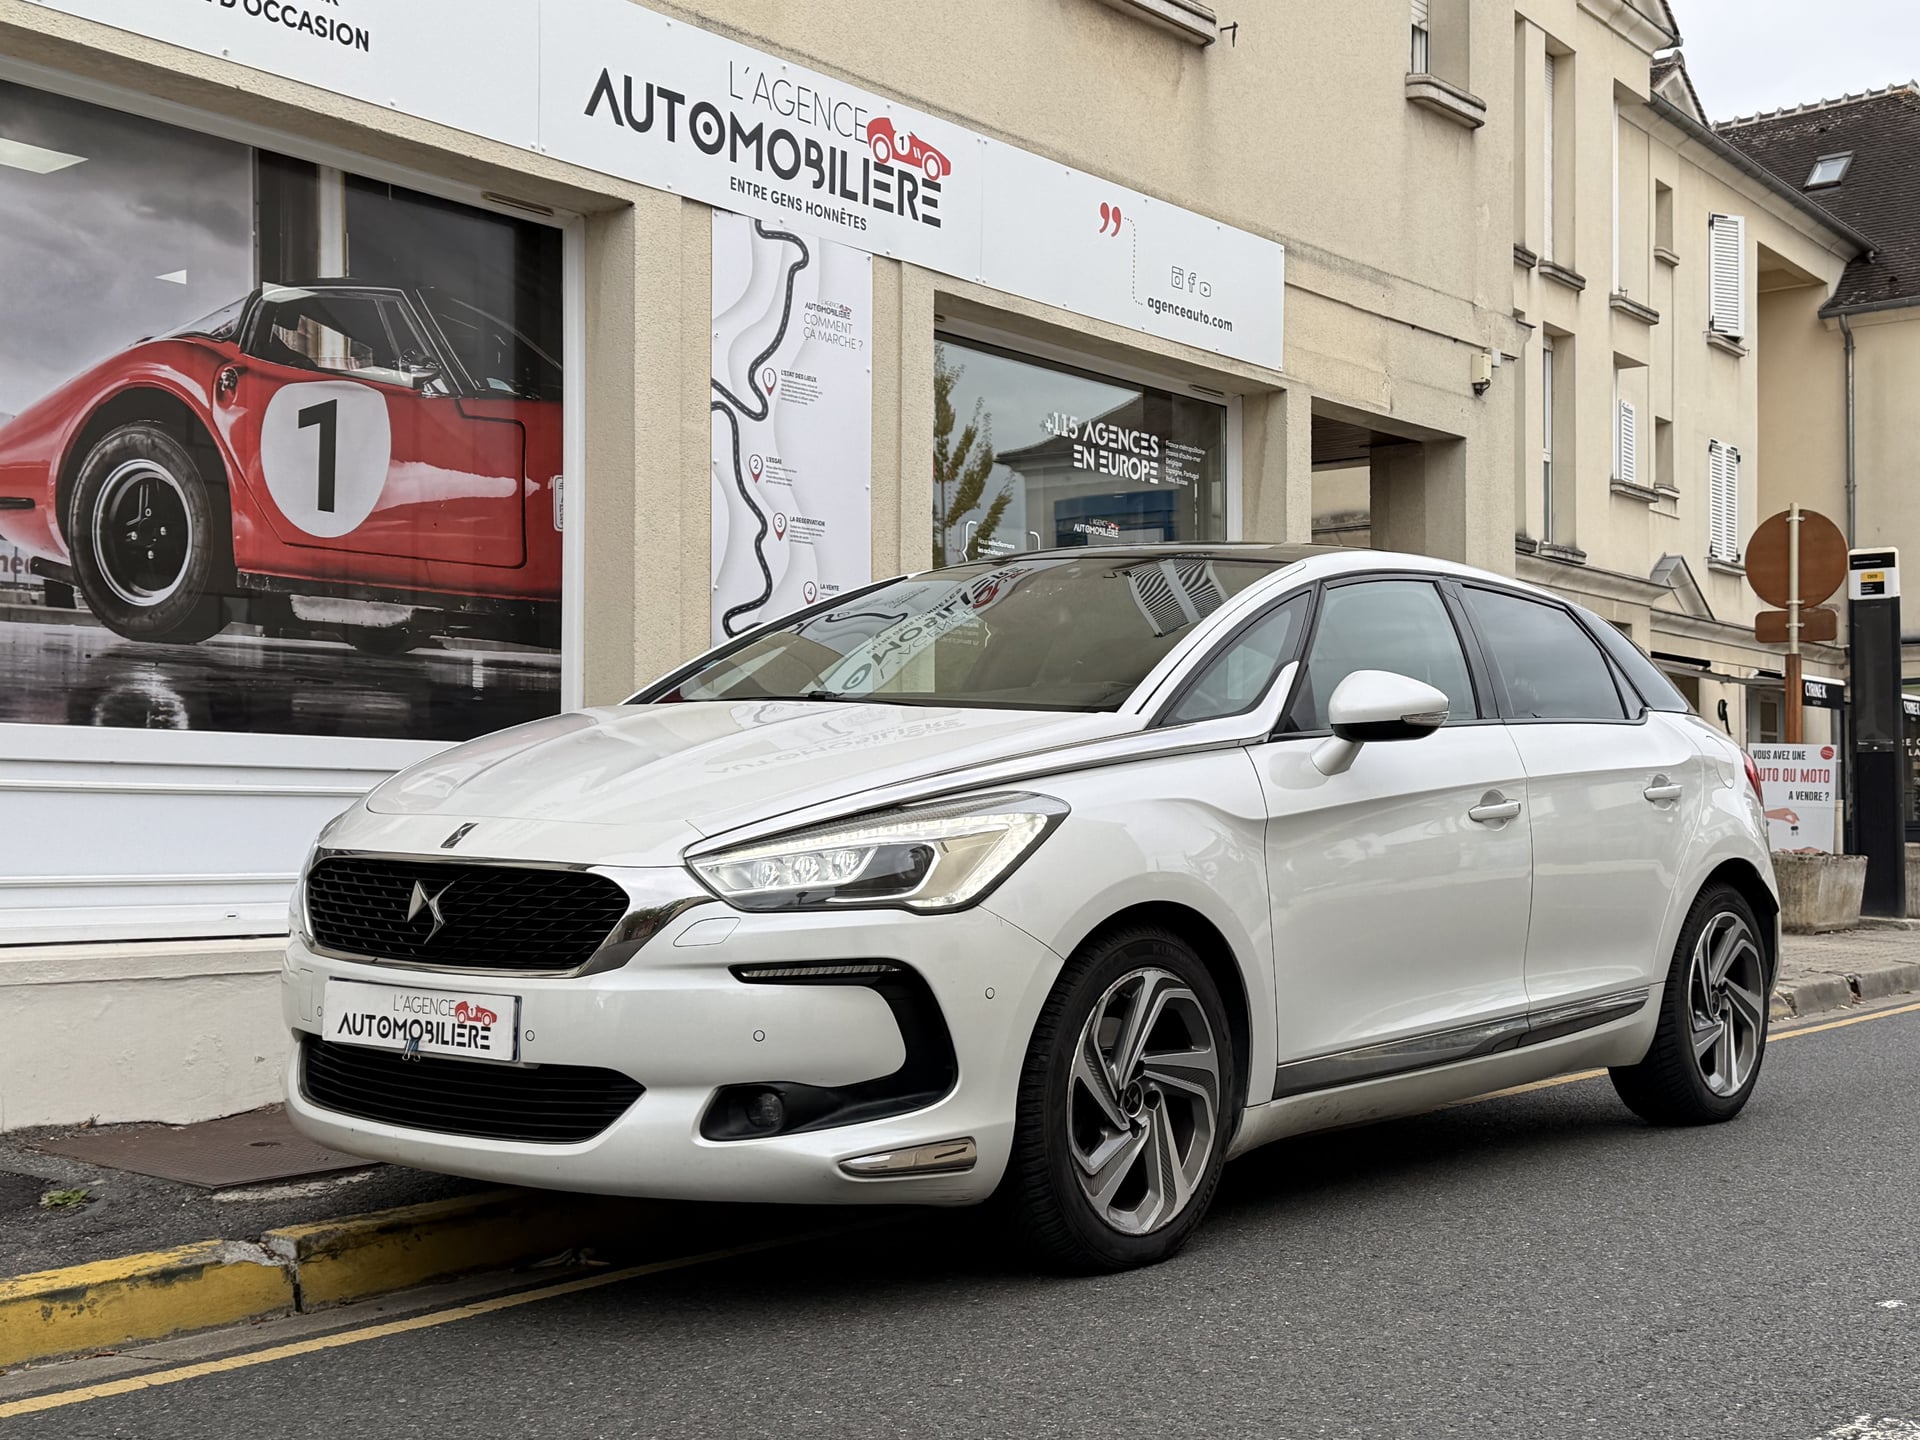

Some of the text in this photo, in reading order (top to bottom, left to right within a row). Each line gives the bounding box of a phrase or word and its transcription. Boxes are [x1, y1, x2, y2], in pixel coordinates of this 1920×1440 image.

[729, 61, 868, 144] L'AGENCE
[730, 176, 867, 231] ENTRE GENS HONNÊTES
[803, 312, 853, 335] COMMENT
[1147, 297, 1233, 332] agenceauto.com
[803, 327, 864, 351] ÇA MARCHE ?
[1045, 411, 1159, 458] +115 AGENCES
[298, 399, 337, 513] 1
[753, 458, 760, 470] 2
[1073, 443, 1159, 485] EN EUROPE
[777, 516, 783, 528] 3
[1753, 750, 1806, 761] VOUS AVEZ UNE
[1759, 767, 1830, 784] UTO OU MOTO
[1788, 790, 1830, 802] A VENDRE ?
[392, 993, 458, 1018] L'AGENCE
